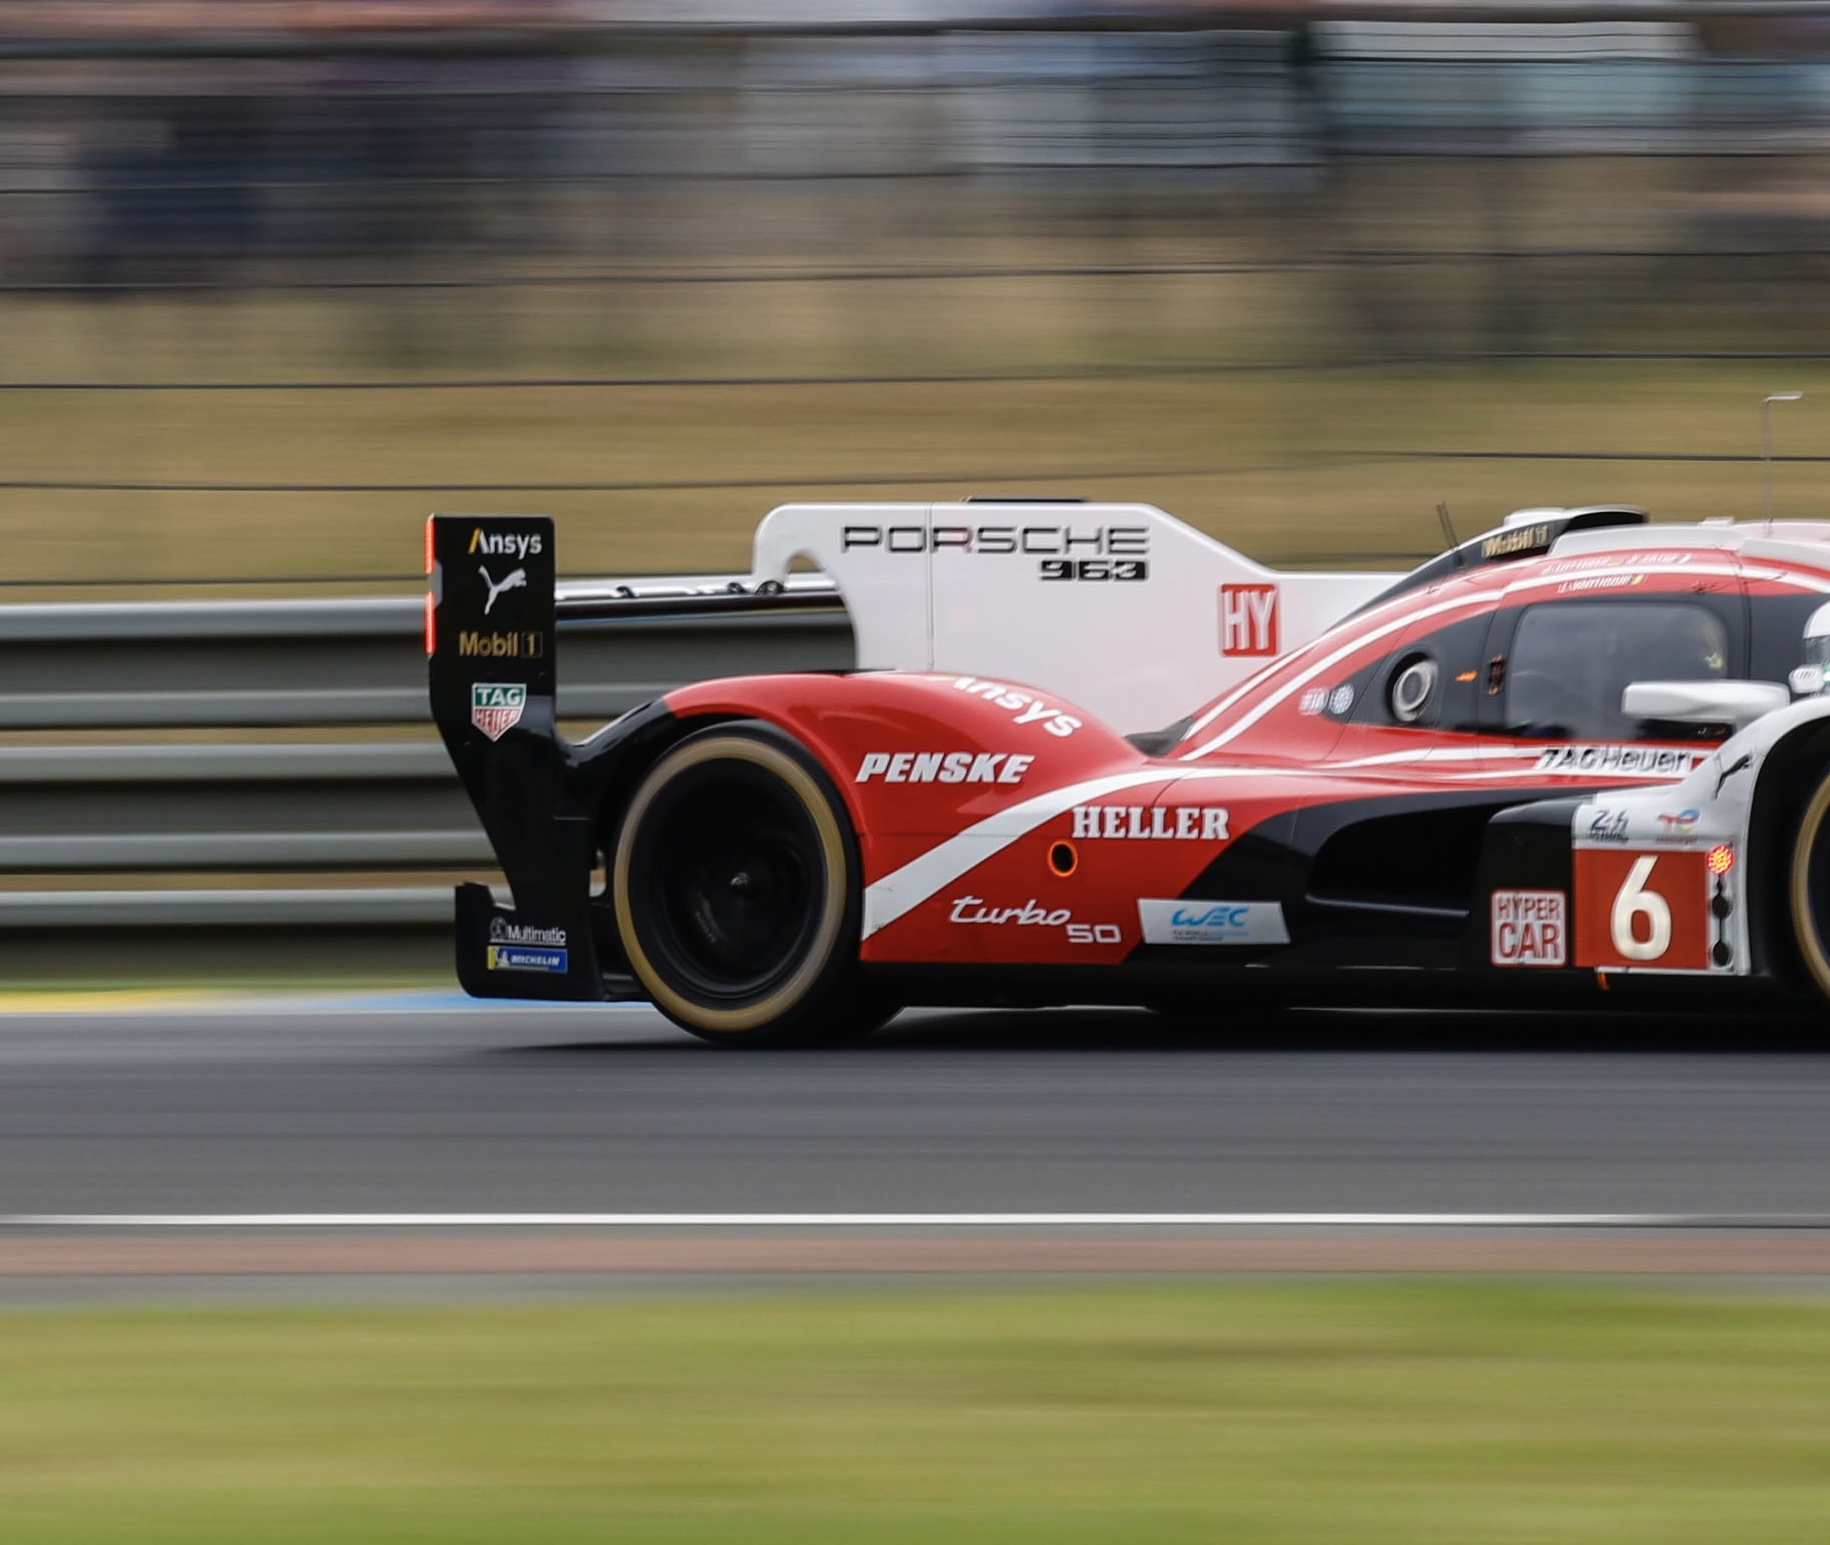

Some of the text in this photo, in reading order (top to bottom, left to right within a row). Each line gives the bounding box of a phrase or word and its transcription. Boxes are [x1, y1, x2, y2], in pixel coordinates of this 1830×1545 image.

[468, 527, 542, 560] Ansys
[841, 526, 1150, 554] PORSCHE
[1038, 559, 1150, 581] 963
[1222, 589, 1275, 651] HY
[459, 630, 518, 657] Mobil
[477, 688, 521, 706] TAG
[475, 708, 519, 733] HEUER
[855, 752, 1035, 784] PENSKE
[1600, 746, 1692, 773] Heuer
[1072, 806, 1229, 840] HELLER
[949, 895, 1121, 944] turbo 50
[1171, 906, 1249, 927] WEC
[1497, 896, 1561, 920] HYPER
[1610, 855, 1672, 961] 6
[507, 924, 567, 943] Multimatic
[1497, 922, 1561, 960] CAR
[510, 954, 561, 967] MICHELIN
